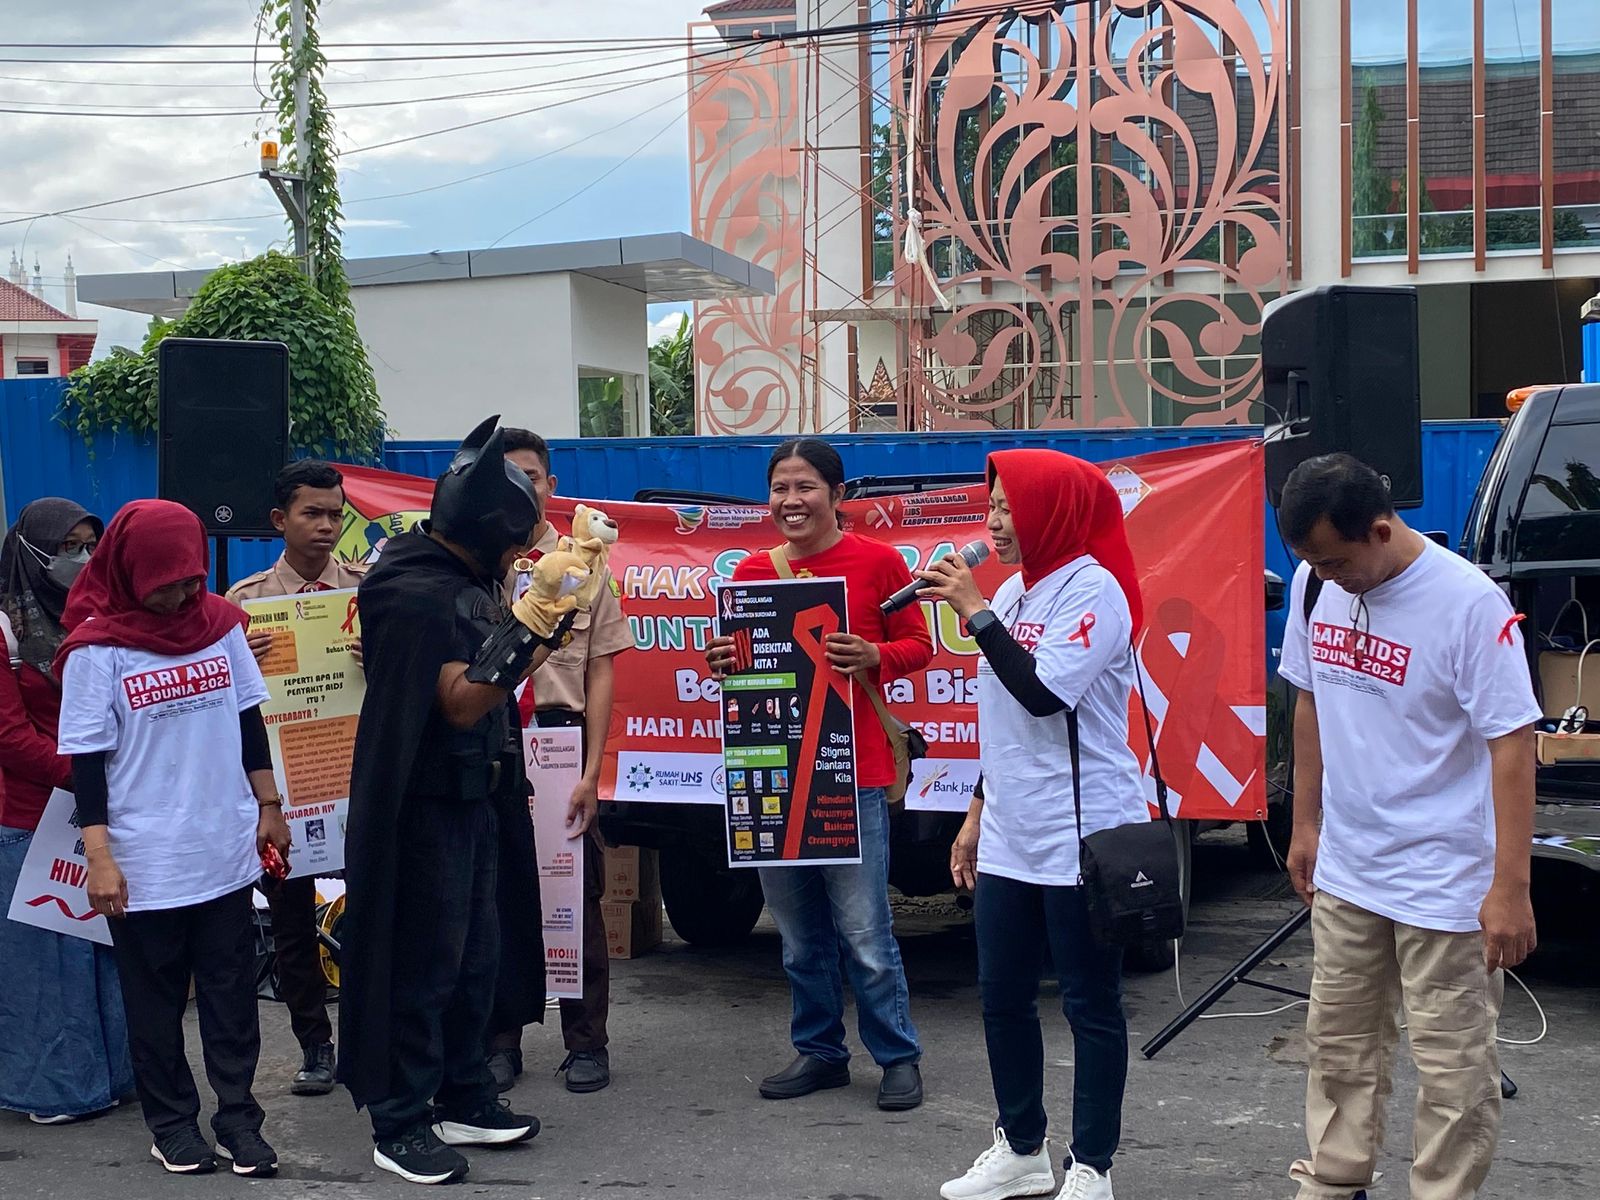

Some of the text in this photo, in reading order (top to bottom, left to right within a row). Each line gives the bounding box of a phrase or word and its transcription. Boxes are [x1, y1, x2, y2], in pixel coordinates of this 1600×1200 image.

[902, 516, 943, 527] KABUPATEN
[625, 567, 708, 600] HAK
[629, 616, 720, 651] UNT
[752, 628, 770, 639] ADA
[1313, 625, 1350, 647] HAR
[753, 642, 792, 654] DISEKITAR
[126, 657, 228, 695] HARI AIDS
[1361, 658, 1402, 682] 2024
[284, 671, 344, 687] SEPERTI APA SIH
[675, 669, 720, 702] Be
[926, 668, 978, 704] Bis
[131, 675, 230, 708] SEDUNIA 2024
[287, 682, 343, 697] PENYAKIT AIDS
[306, 696, 319, 705] ITU
[264, 709, 312, 725] ENYEBABNYA
[626, 716, 684, 738] HARI
[829, 733, 849, 745] Stop
[821, 746, 851, 759] Stigma
[815, 760, 851, 771] Diantara
[655, 770, 679, 778] RUMAH
[681, 772, 703, 783] UNS
[835, 773, 851, 783] Kita
[659, 779, 679, 787] SAKIT
[934, 780, 974, 795] Bank Jat
[284, 806, 320, 821] NULARAN
[73, 837, 87, 857] da
